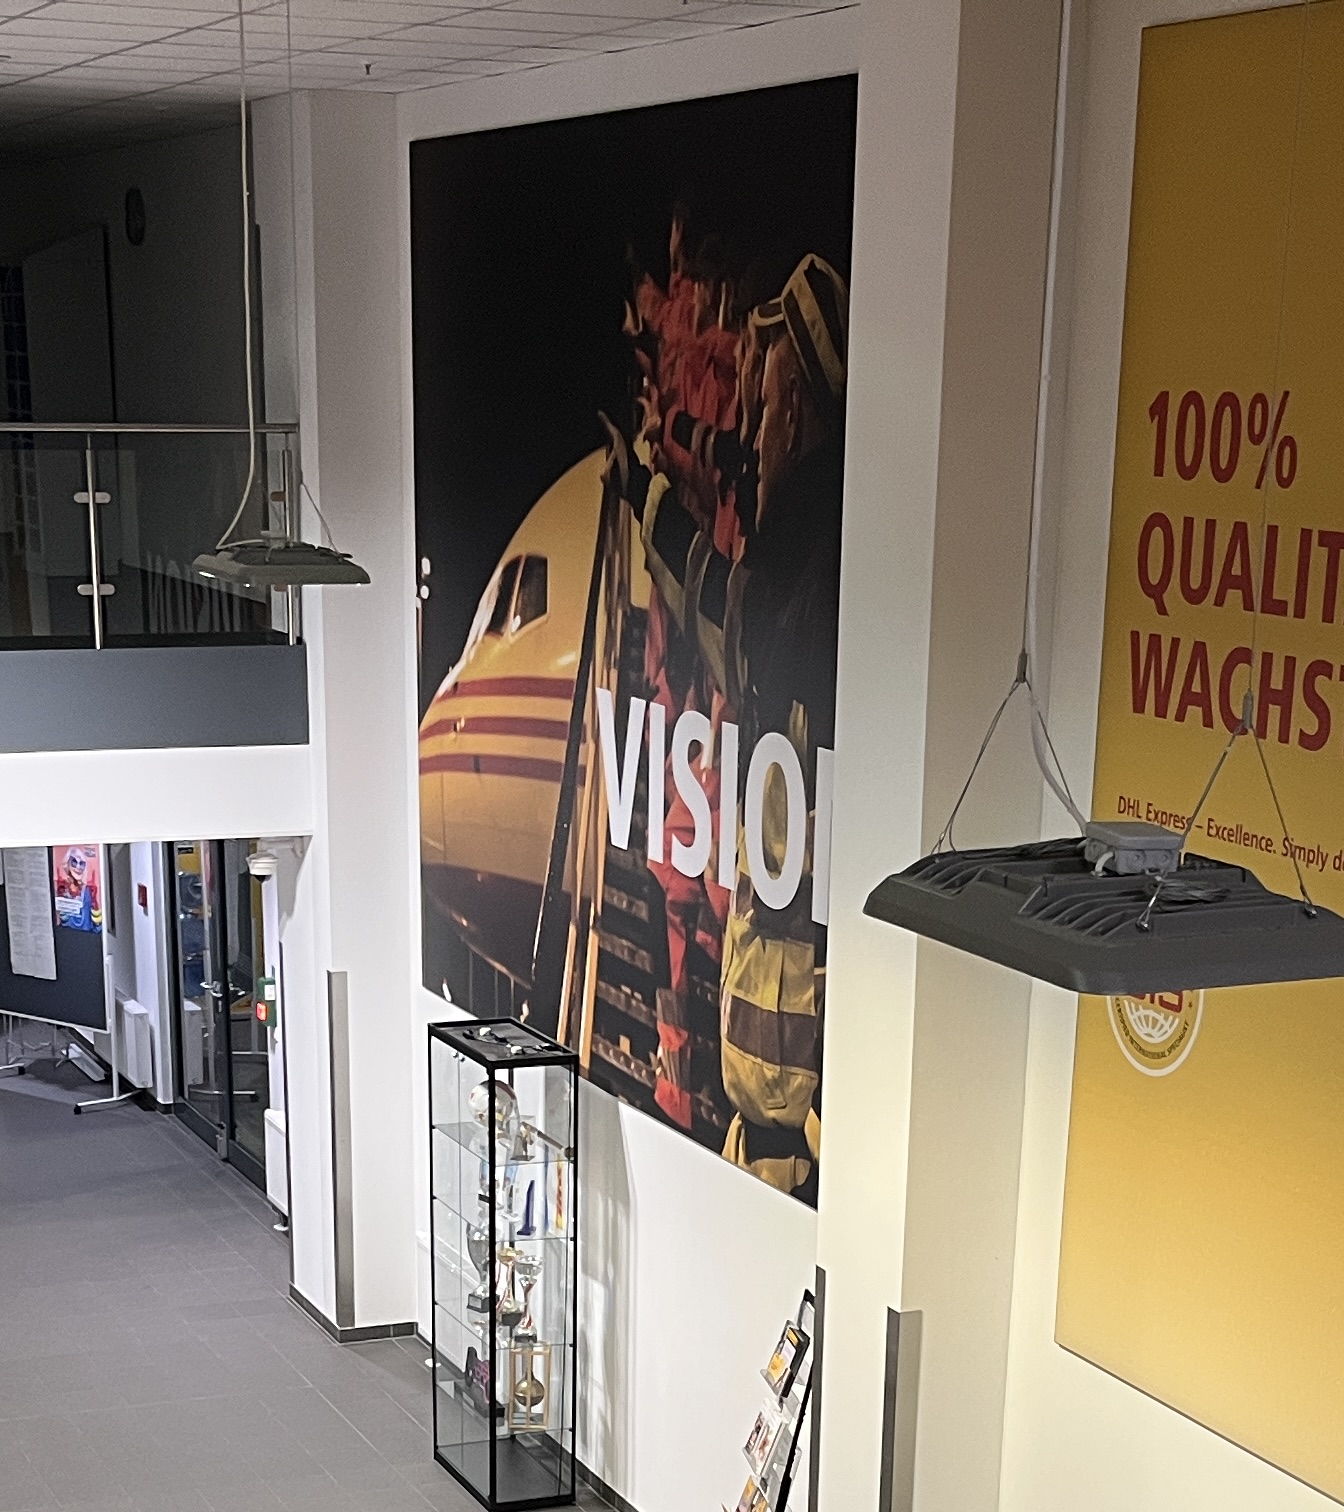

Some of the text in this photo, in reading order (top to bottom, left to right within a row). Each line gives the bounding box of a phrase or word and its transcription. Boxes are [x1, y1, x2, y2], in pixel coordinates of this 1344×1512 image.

[1148, 390, 1298, 490] 100%
[1117, 795, 1142, 819] DHL
[1145, 801, 1192, 831] Express
[1206, 817, 1276, 855] Excellence.
[1281, 836, 1329, 872] Simply
